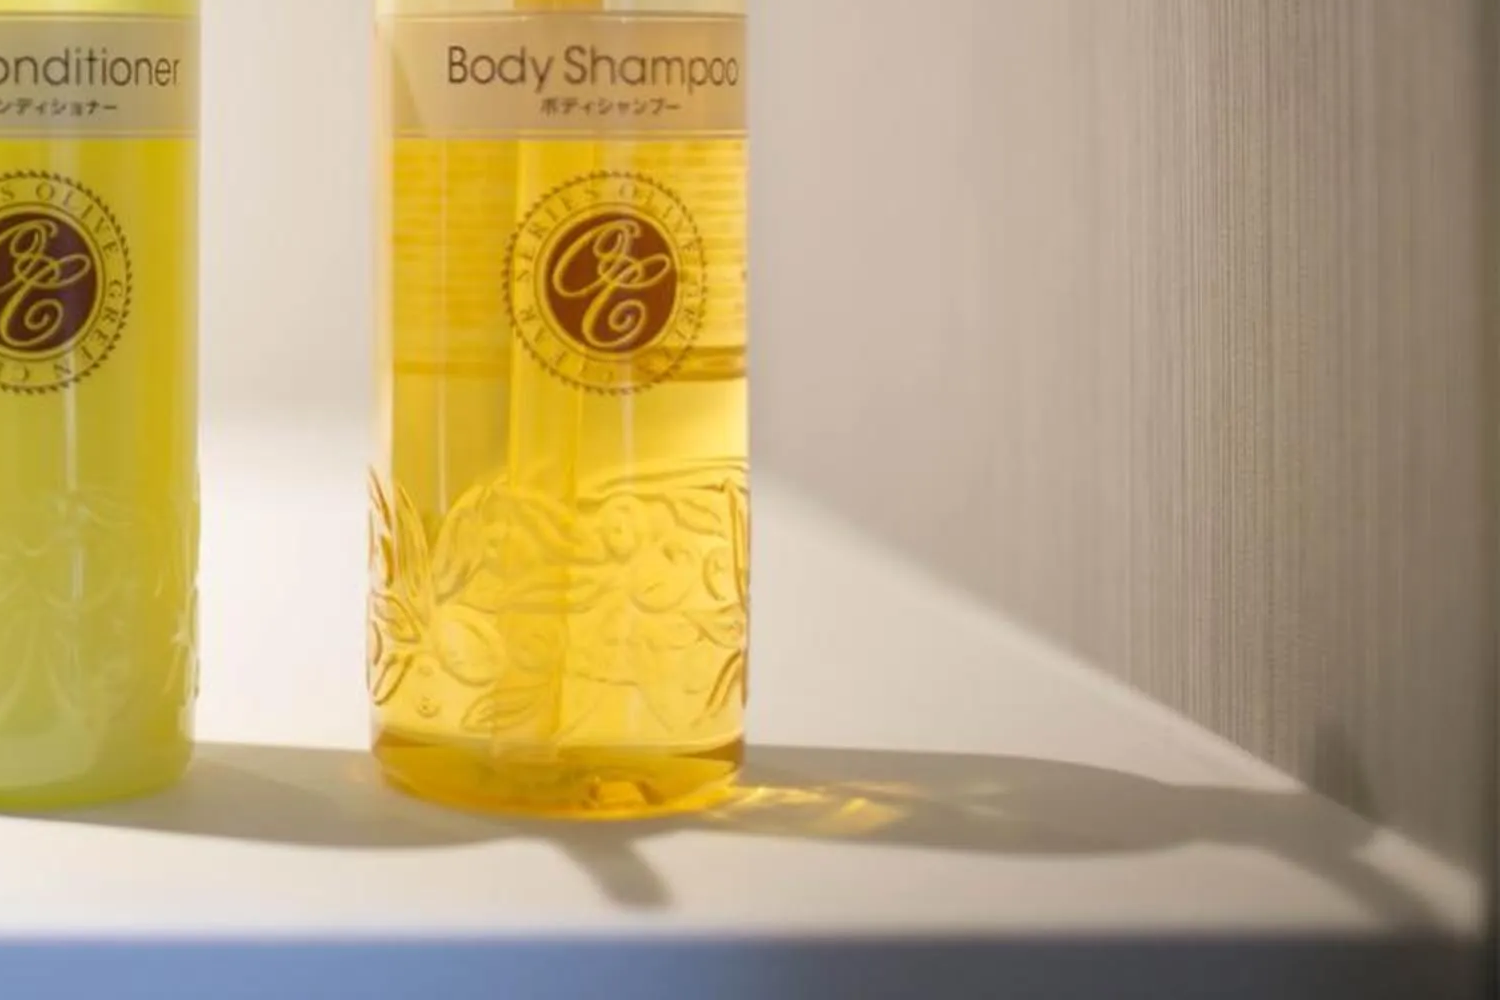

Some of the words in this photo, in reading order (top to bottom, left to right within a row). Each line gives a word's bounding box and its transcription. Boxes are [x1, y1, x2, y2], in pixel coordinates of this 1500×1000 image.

[448, 45, 554, 92] Body
[563, 45, 739, 94] Shampoo
[35, 181, 120, 261] OLIVE
[52, 279, 123, 377] GREEN
